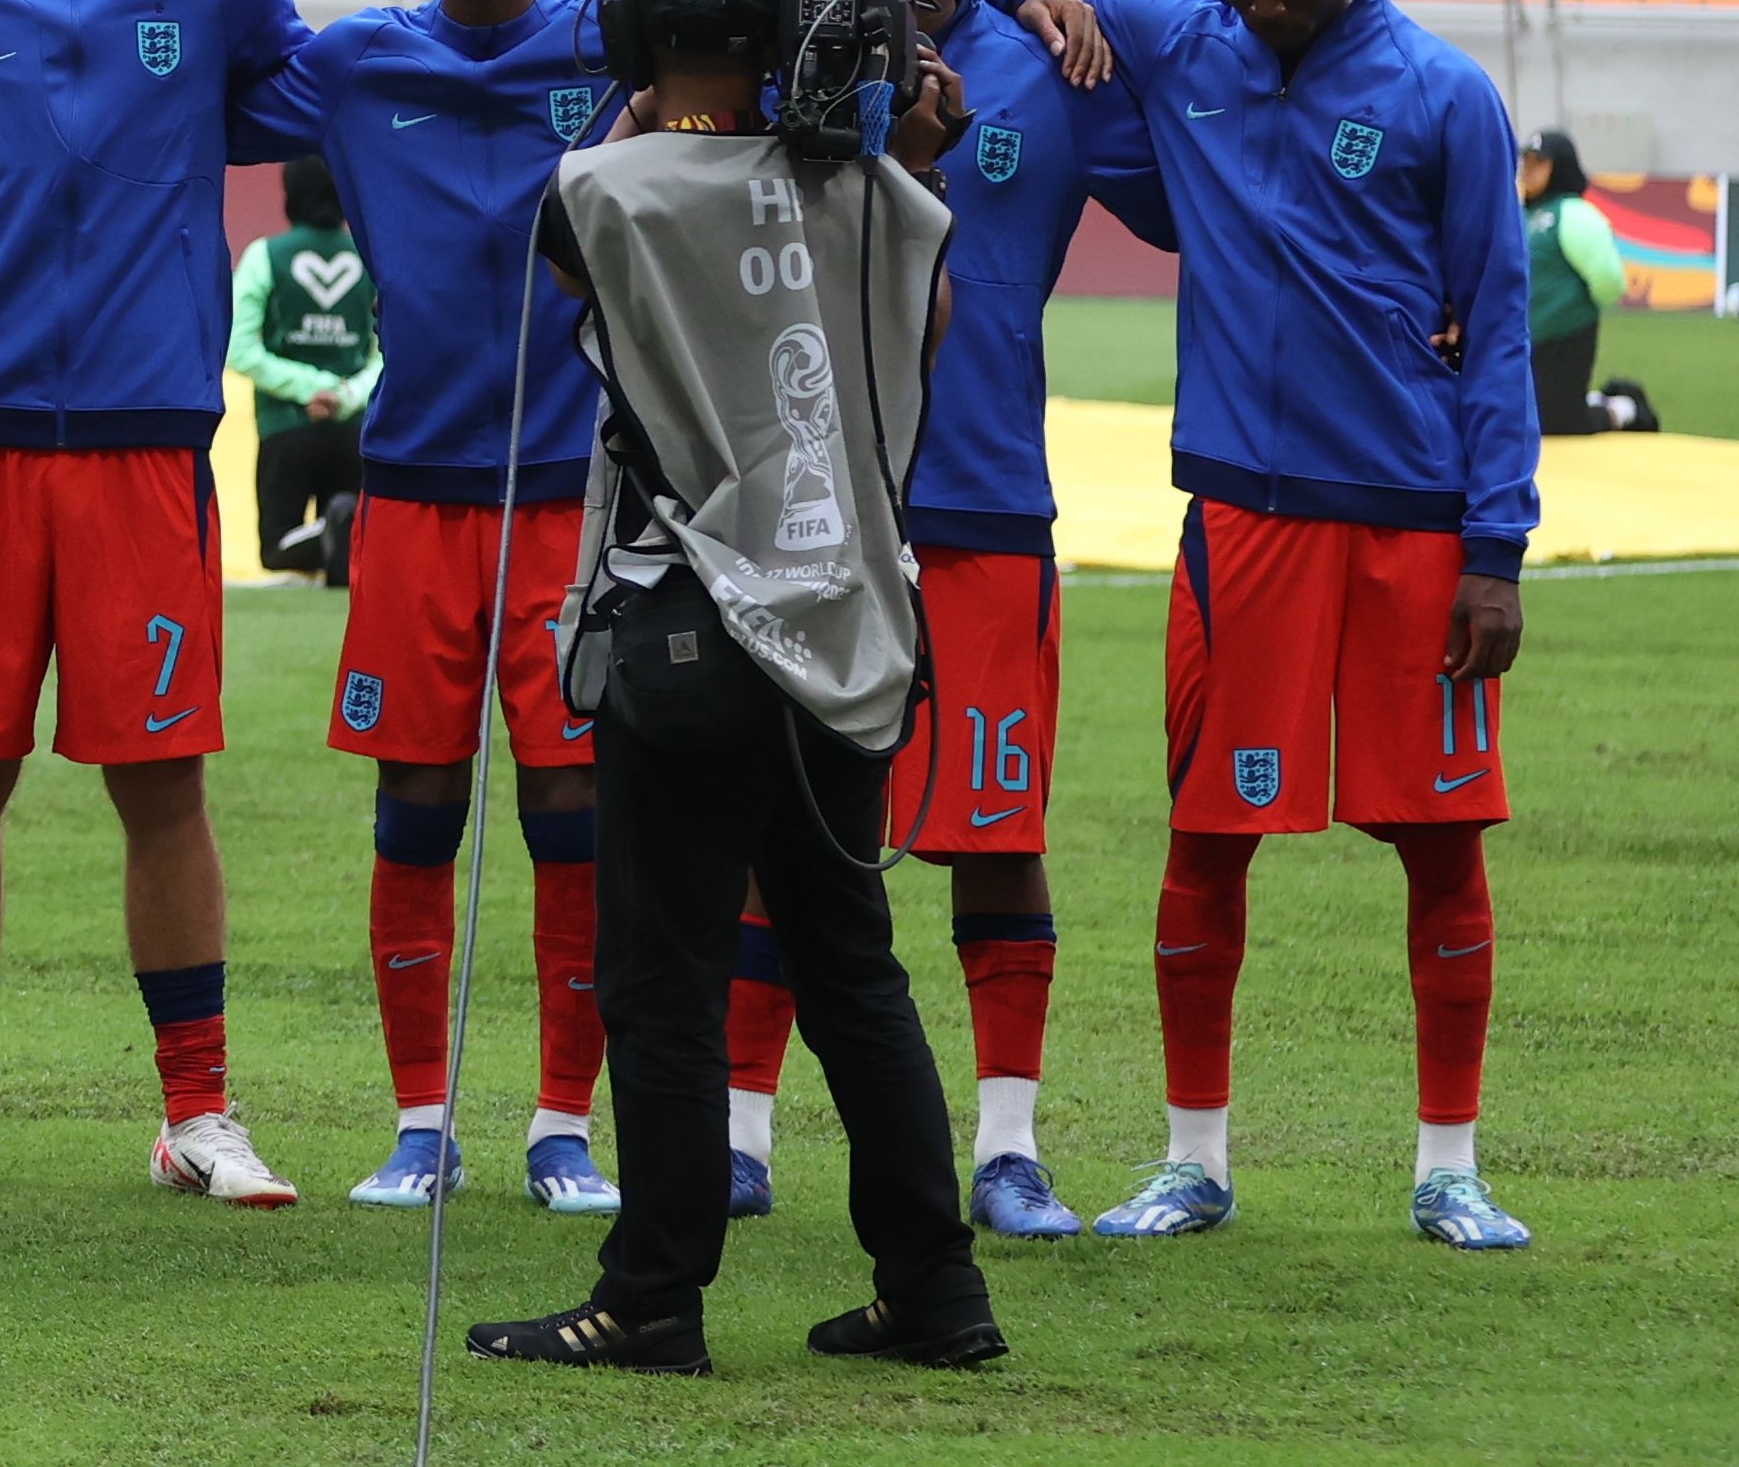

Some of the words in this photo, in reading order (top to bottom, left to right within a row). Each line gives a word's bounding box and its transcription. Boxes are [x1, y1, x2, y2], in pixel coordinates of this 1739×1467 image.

[786, 518, 831, 541] FIFA
[145, 613, 185, 697] 7
[965, 706, 1030, 793] 16
[1436, 671, 1489, 756] 11
